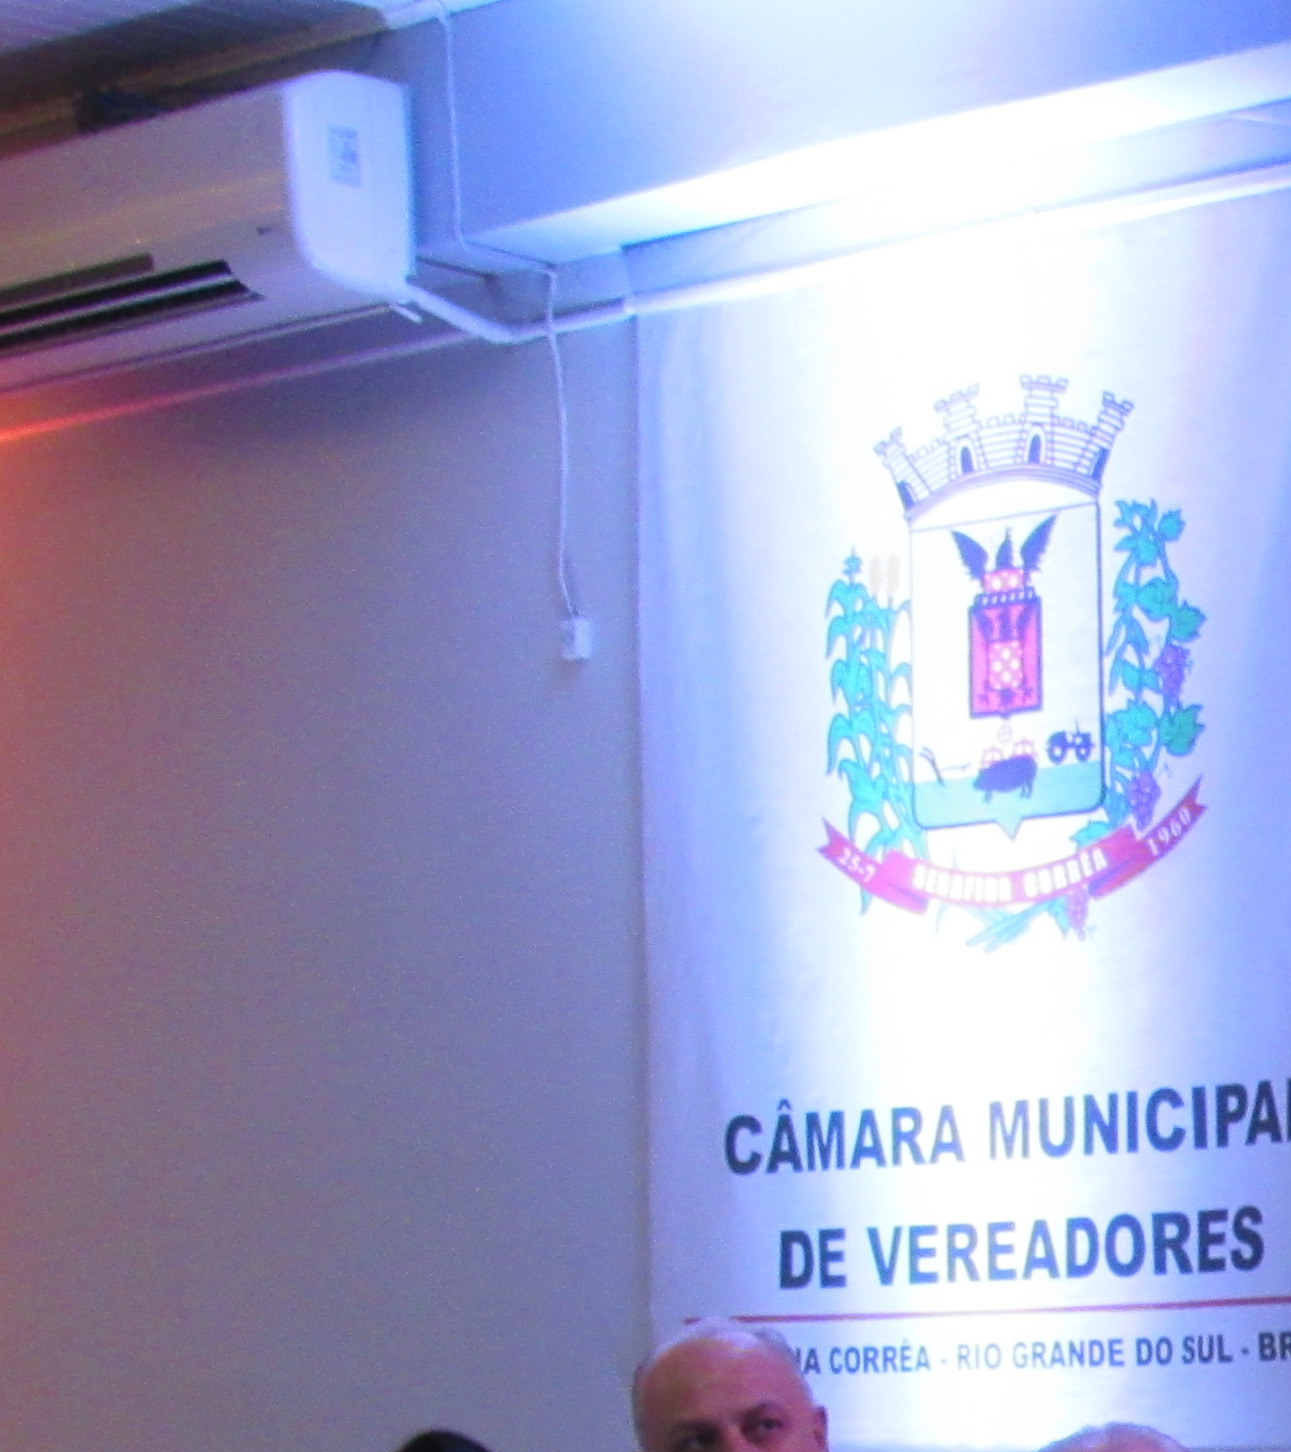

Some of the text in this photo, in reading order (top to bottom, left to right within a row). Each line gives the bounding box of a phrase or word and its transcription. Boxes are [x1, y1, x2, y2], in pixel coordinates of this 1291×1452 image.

[723, 1098, 966, 1177] CÂMARA
[778, 1205, 1265, 1290] DE VEREADORES
[829, 1338, 931, 1375] CORRÊA
[956, 1343, 1003, 1370] RIO
[1012, 1338, 1126, 1370] GRANDE
[1135, 1336, 1175, 1367] DO
[1181, 1333, 1233, 1364] SUL
